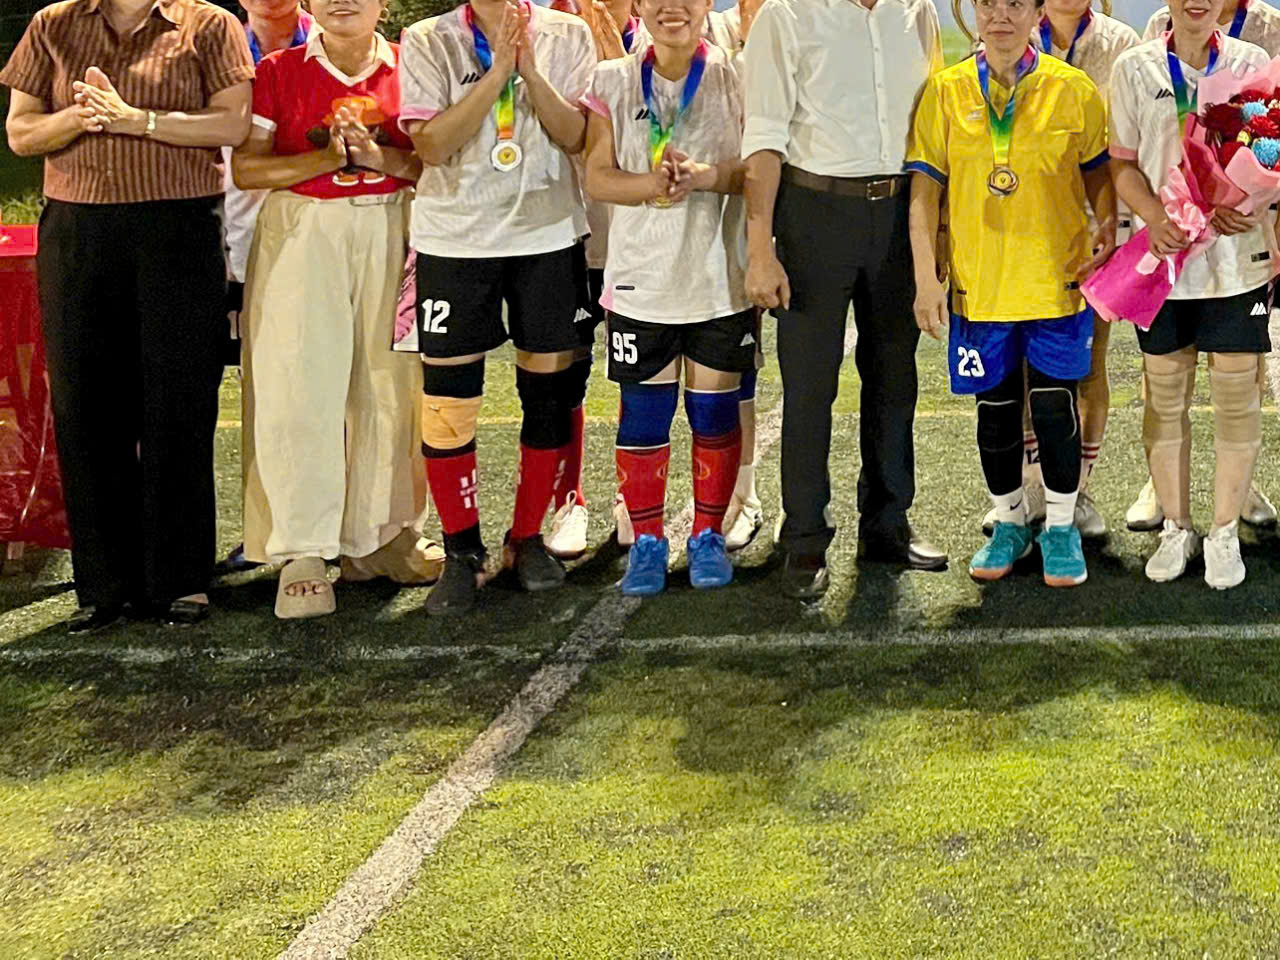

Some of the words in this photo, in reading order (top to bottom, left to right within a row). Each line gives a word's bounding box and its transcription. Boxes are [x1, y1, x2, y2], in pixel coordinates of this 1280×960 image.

[226, 310, 241, 340] 1
[421, 298, 451, 334] 12
[612, 331, 638, 365] 95
[957, 346, 985, 377] 23
